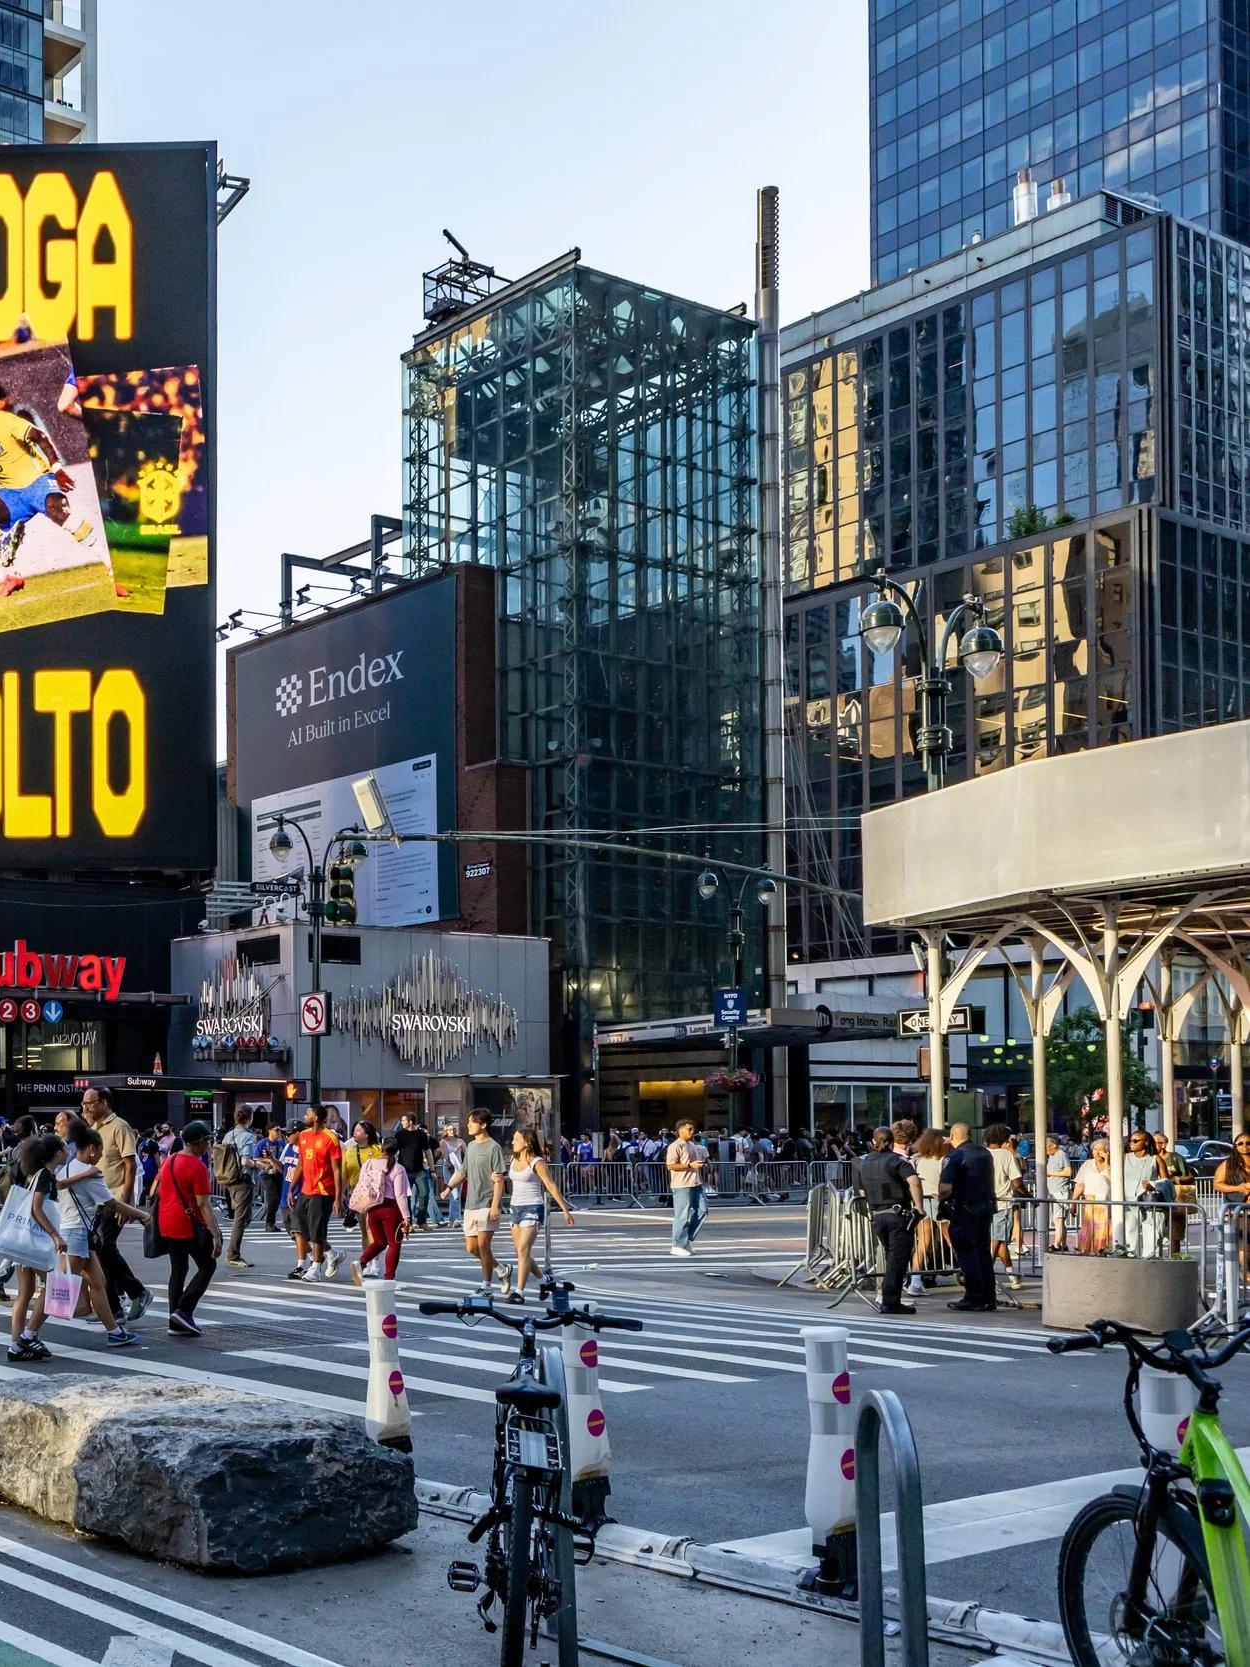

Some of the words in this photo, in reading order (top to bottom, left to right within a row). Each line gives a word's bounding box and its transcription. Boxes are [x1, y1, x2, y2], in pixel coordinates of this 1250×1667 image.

[308, 651, 405, 707] Endex
[287, 728, 303, 748] AI
[306, 719, 334, 742] Built
[338, 716, 351, 732] in
[354, 701, 391, 729] Excel
[465, 867, 490, 878] 922307
[255, 883, 298, 892] SILVERCAST
[196, 1014, 264, 1036] SWAROVSKI
[391, 1014, 470, 1033] SWAROVSKI
[911, 1017, 928, 1028] ONE
[690, 1026, 707, 1034] Long
[16, 1079, 32, 1093] THE
[33, 1079, 56, 1093] PENN
[127, 1077, 156, 1088] Subway
[305, 1148, 313, 1160] 19
